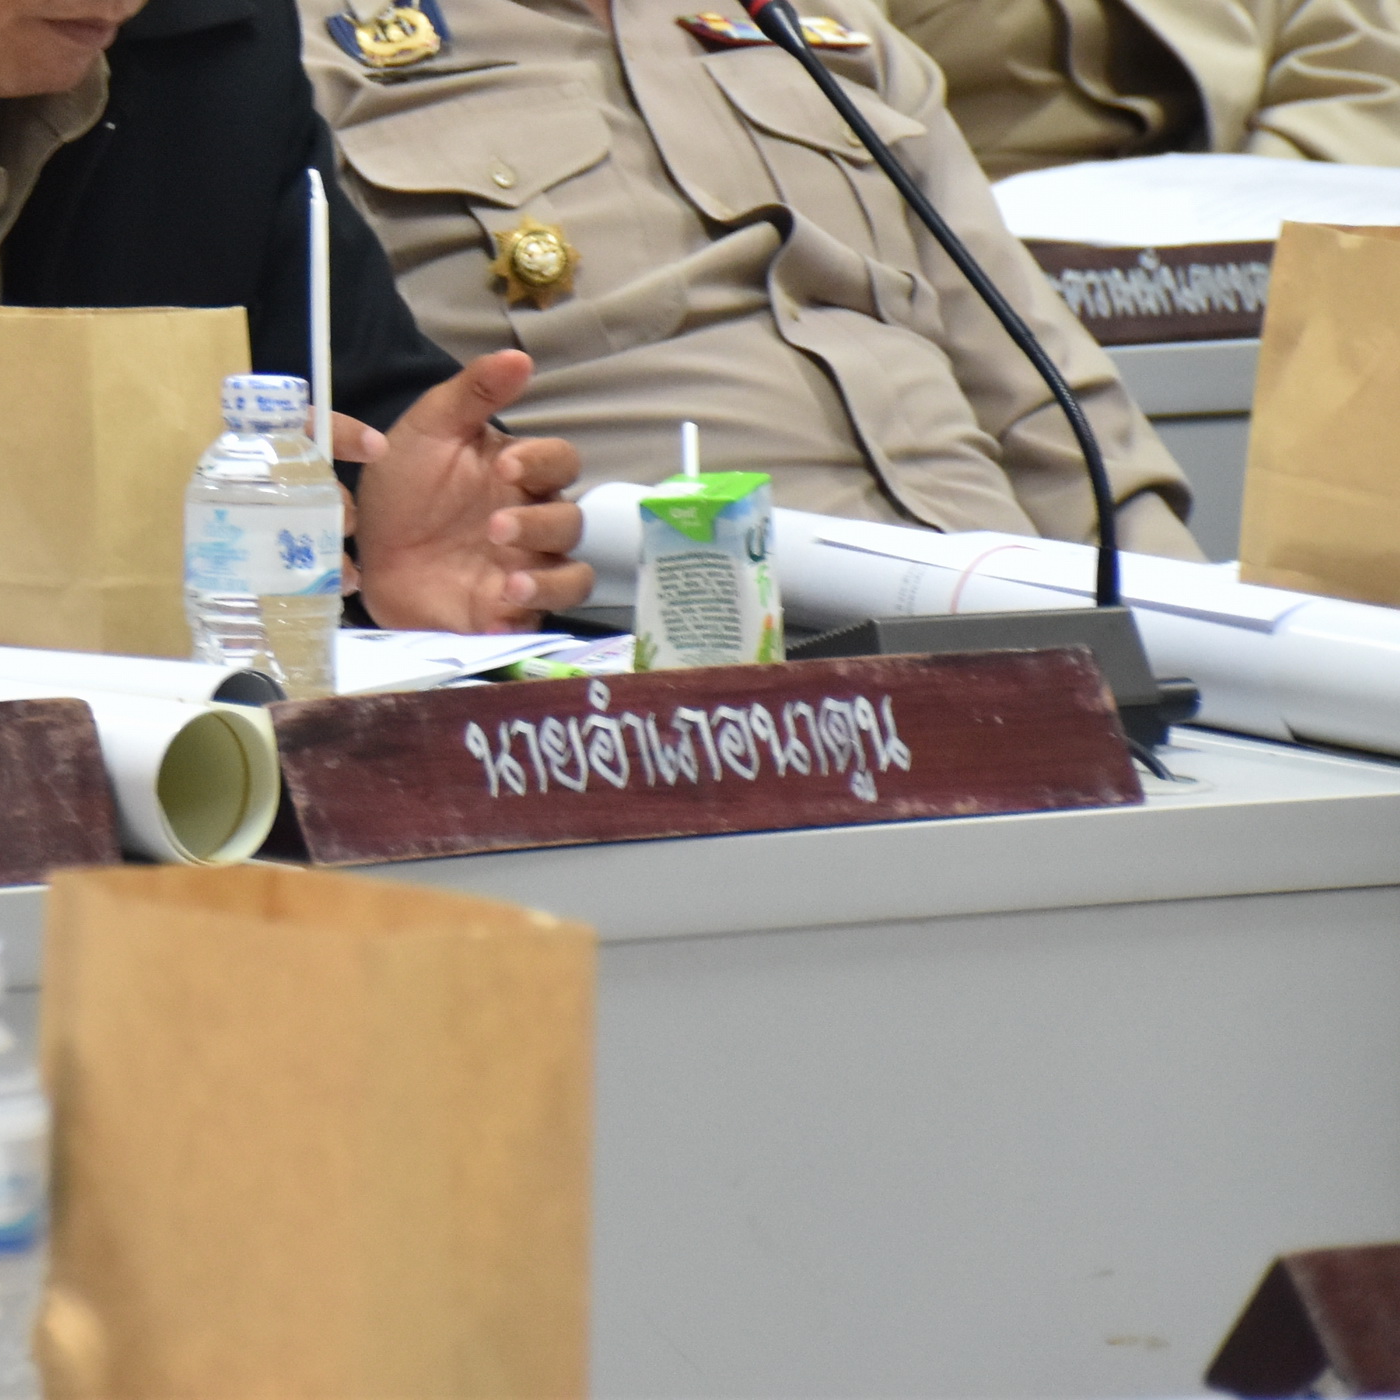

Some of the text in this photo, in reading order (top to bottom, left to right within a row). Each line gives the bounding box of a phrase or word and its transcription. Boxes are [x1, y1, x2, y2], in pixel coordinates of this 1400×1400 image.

[464, 679, 912, 802] นายอำเภอนาดูน
